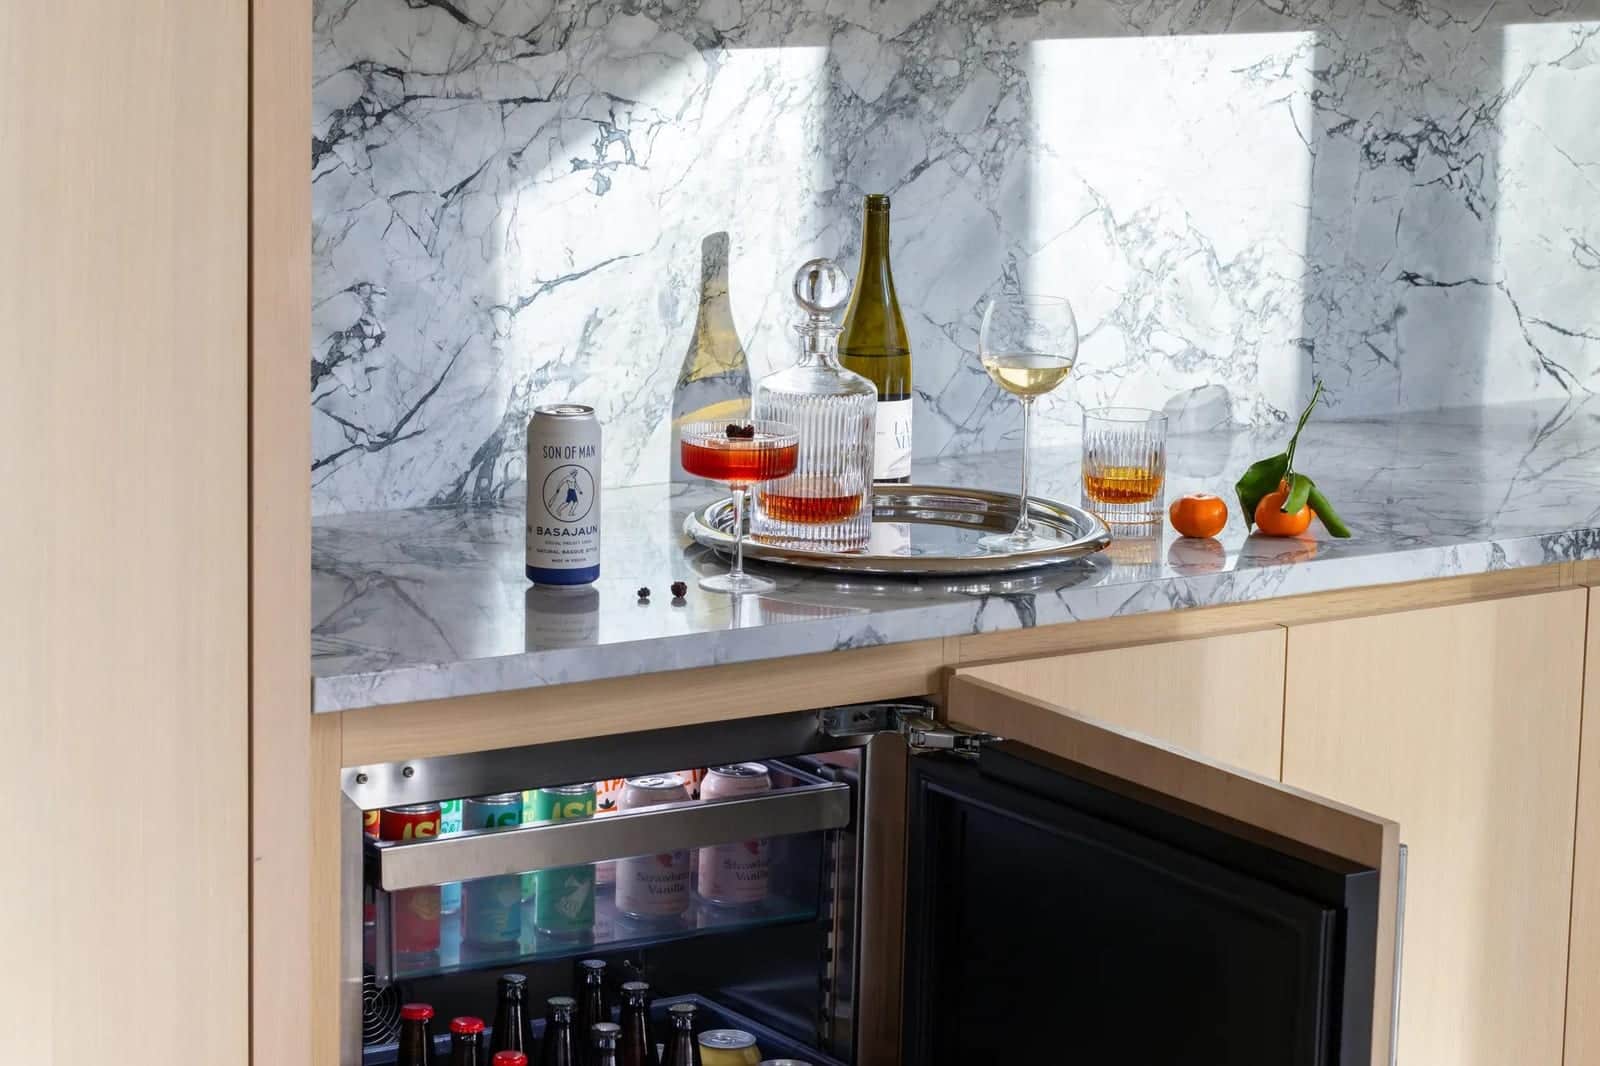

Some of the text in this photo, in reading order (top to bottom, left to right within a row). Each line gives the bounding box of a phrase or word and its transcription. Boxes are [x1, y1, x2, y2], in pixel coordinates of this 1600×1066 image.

[543, 444, 595, 459] SON OF MAN
[536, 525, 598, 537] BASAJAUN
